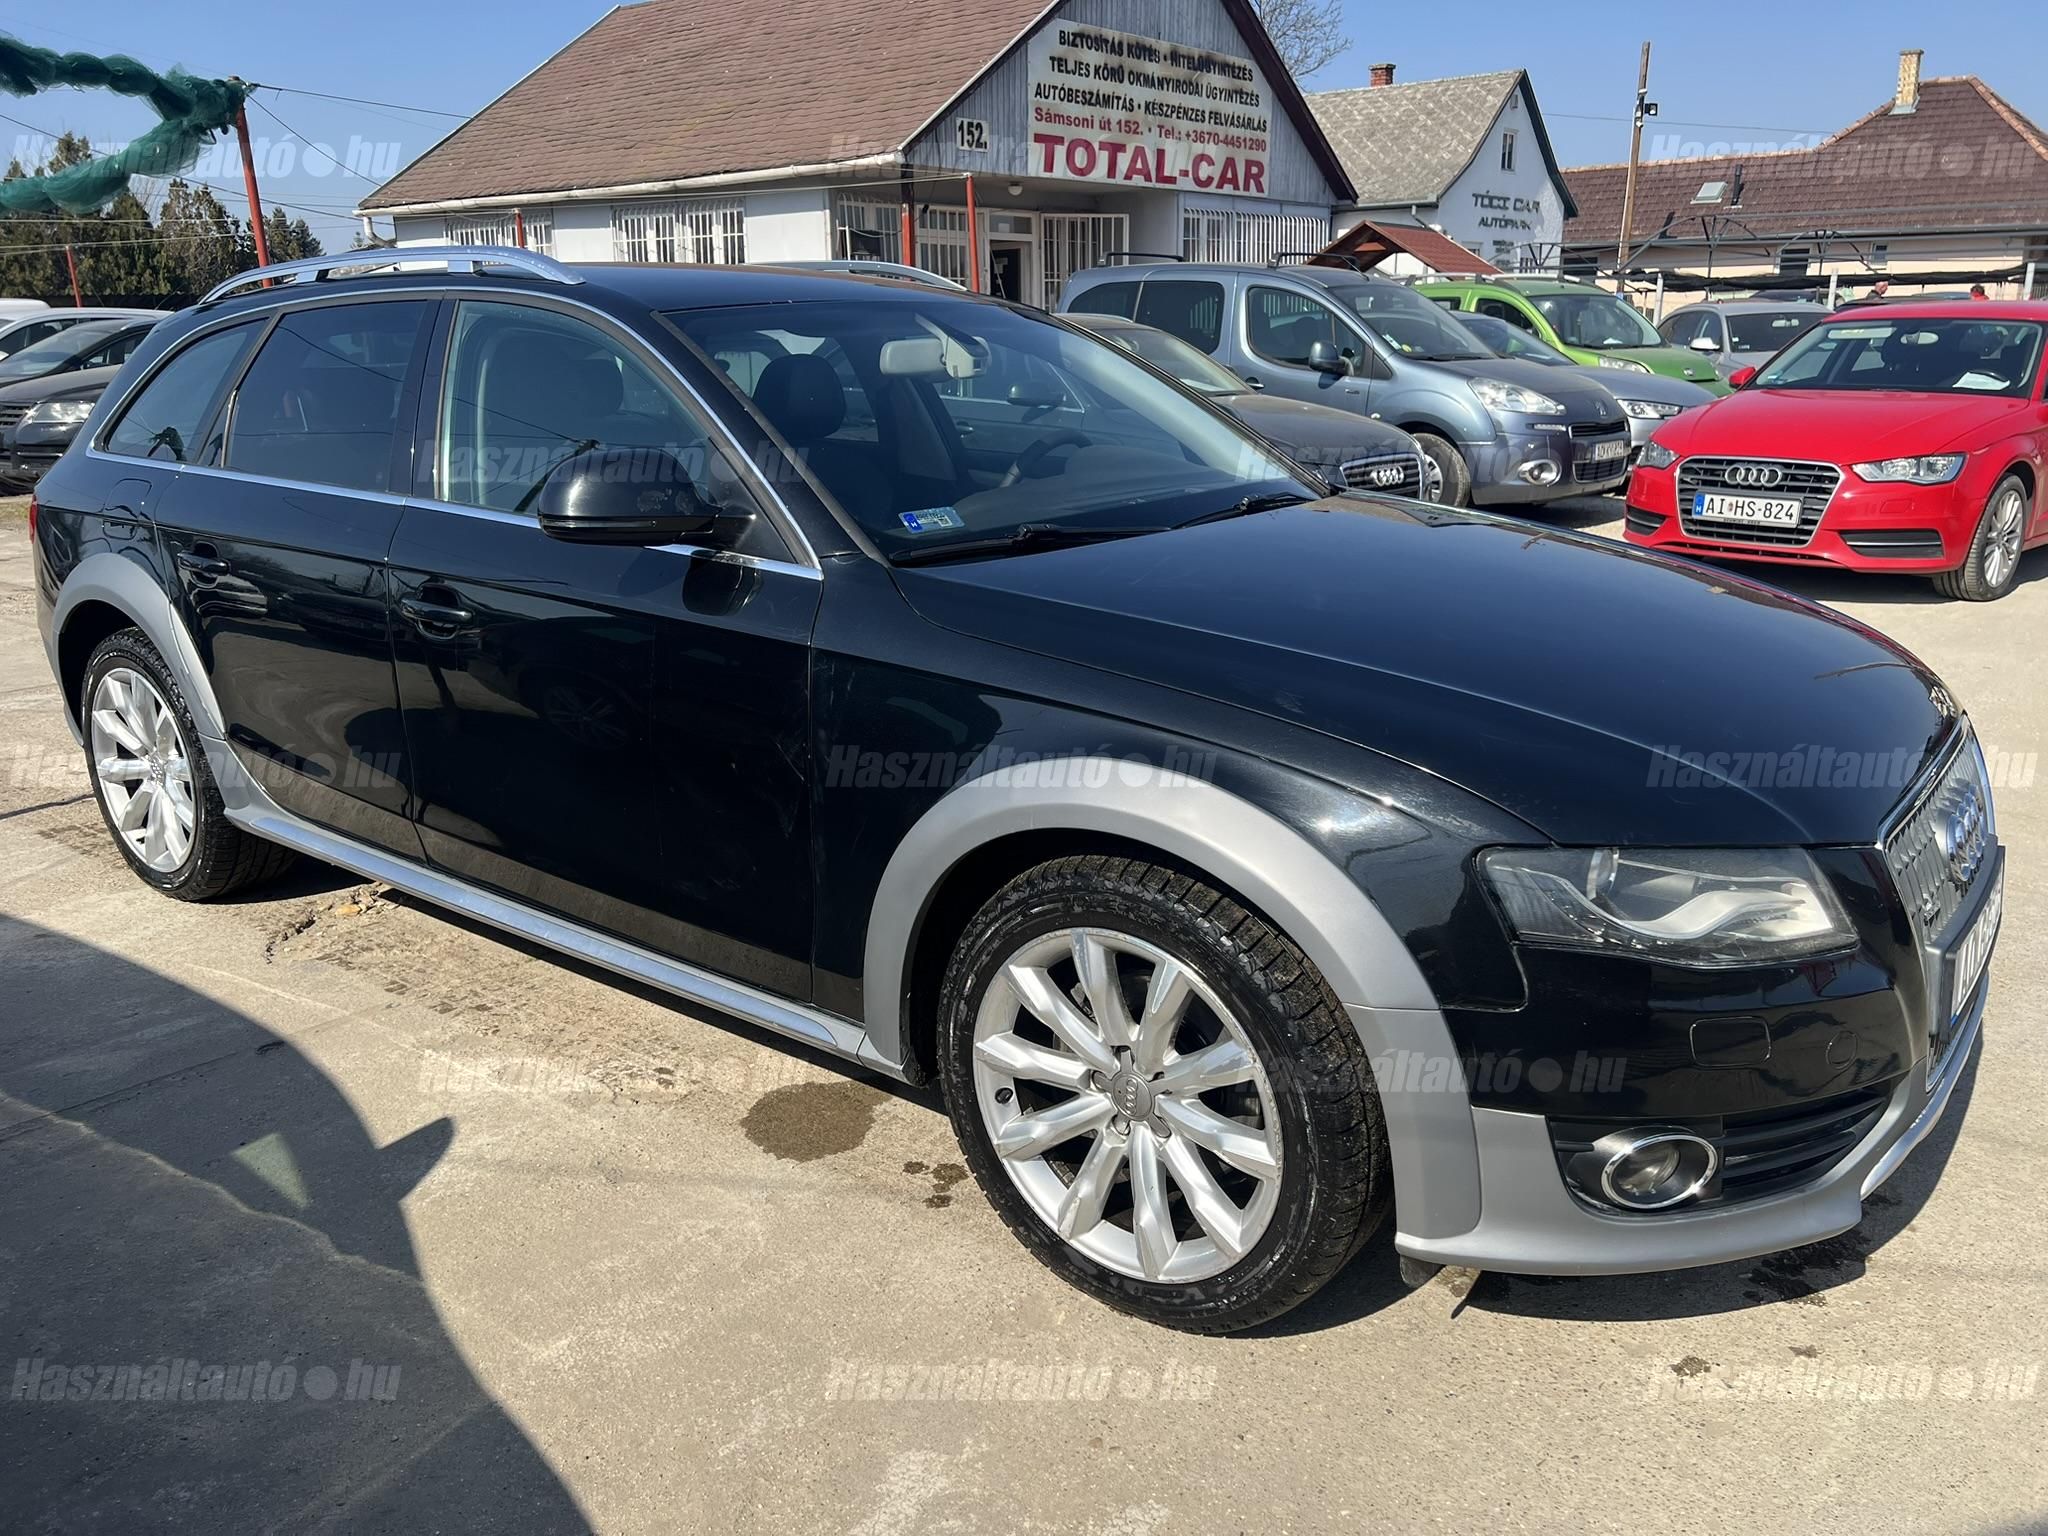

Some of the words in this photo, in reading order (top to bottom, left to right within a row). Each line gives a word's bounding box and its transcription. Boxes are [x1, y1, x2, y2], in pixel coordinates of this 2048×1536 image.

[1059, 30, 1124, 57] BIZTOSÍTÁS
[1049, 56, 1091, 79] TELJES
[1128, 69, 1204, 98] OKMÁNYIRODAI
[1205, 82, 1260, 108] ÜGYINTÉZÉS
[1034, 82, 1135, 112] AUTÓBESZÁMÍTÁS
[1144, 98, 1206, 124] KÉSZPÉNZES
[1208, 110, 1268, 133] FELVÁSÁRLÁS
[1034, 106, 1095, 130] Sámsoni
[1099, 115, 1113, 132] út
[1116, 118, 1144, 136] 152.
[1157, 124, 1182, 141] Tel.:
[1185, 129, 1267, 153] +3670-4451290
[958, 120, 988, 149] 152.
[1034, 133, 1265, 193] TOTAL-CAR
[1734, 500, 1794, 521] HS-824
